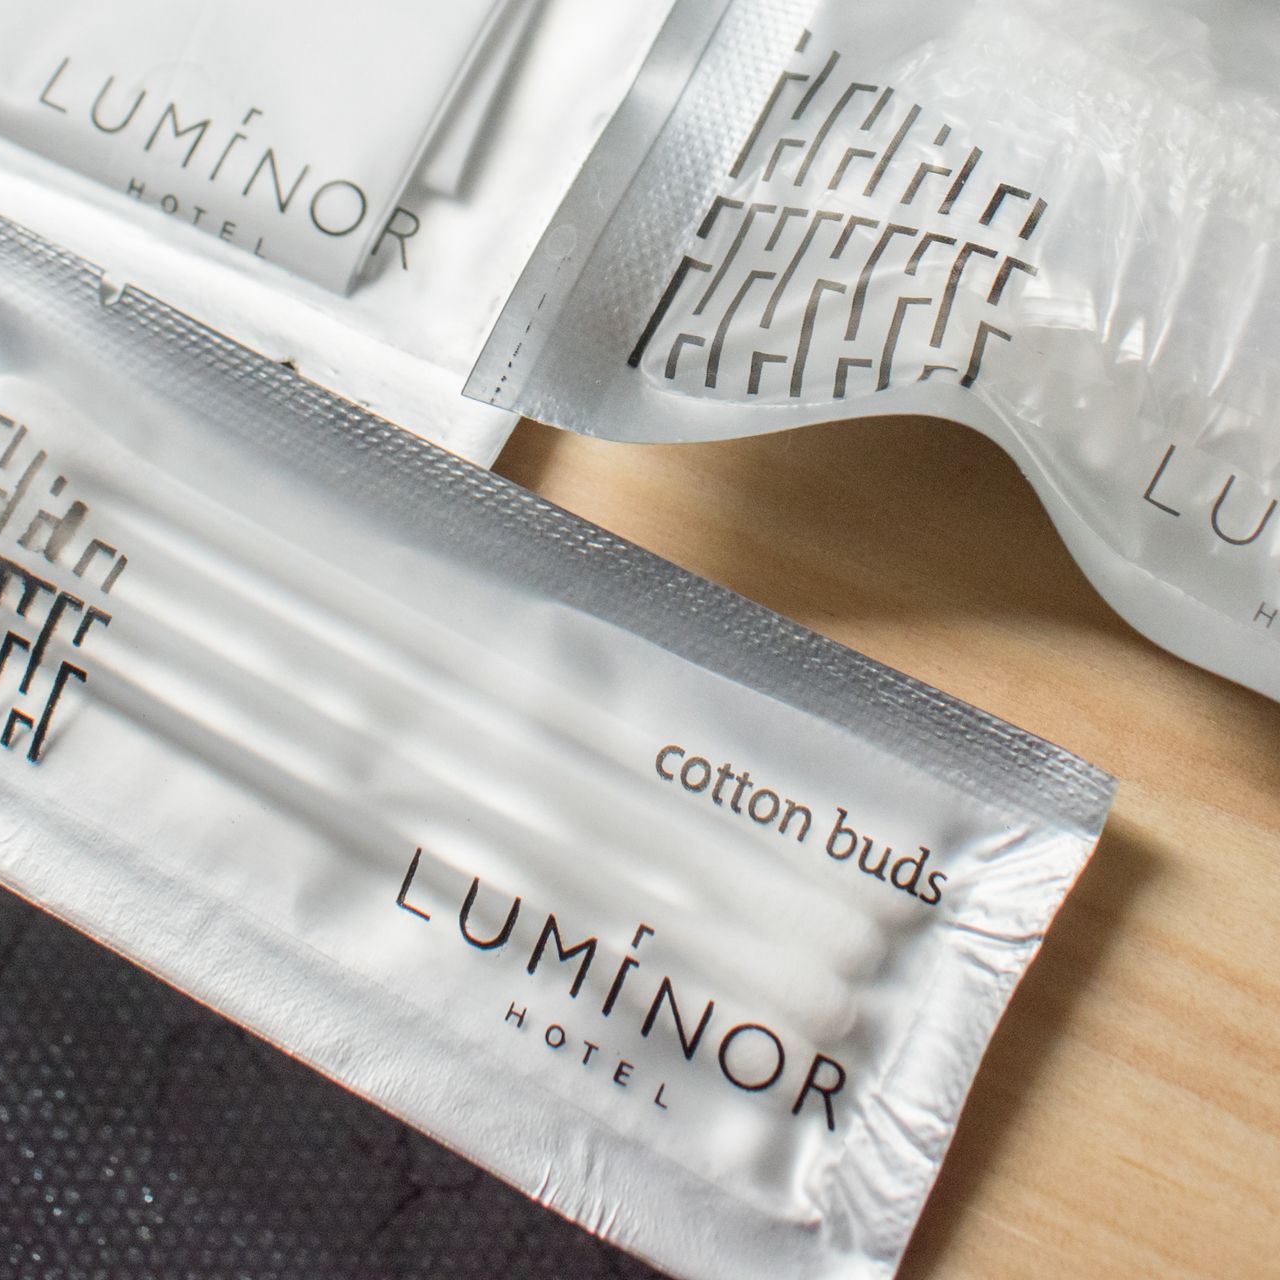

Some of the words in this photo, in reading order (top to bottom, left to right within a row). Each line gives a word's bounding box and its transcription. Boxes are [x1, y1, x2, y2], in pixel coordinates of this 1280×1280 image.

[126, 177, 267, 259] HOTEL
[654, 743, 813, 843] cotton
[825, 807, 948, 907] buds
[504, 1001, 668, 1109] HOTEL
